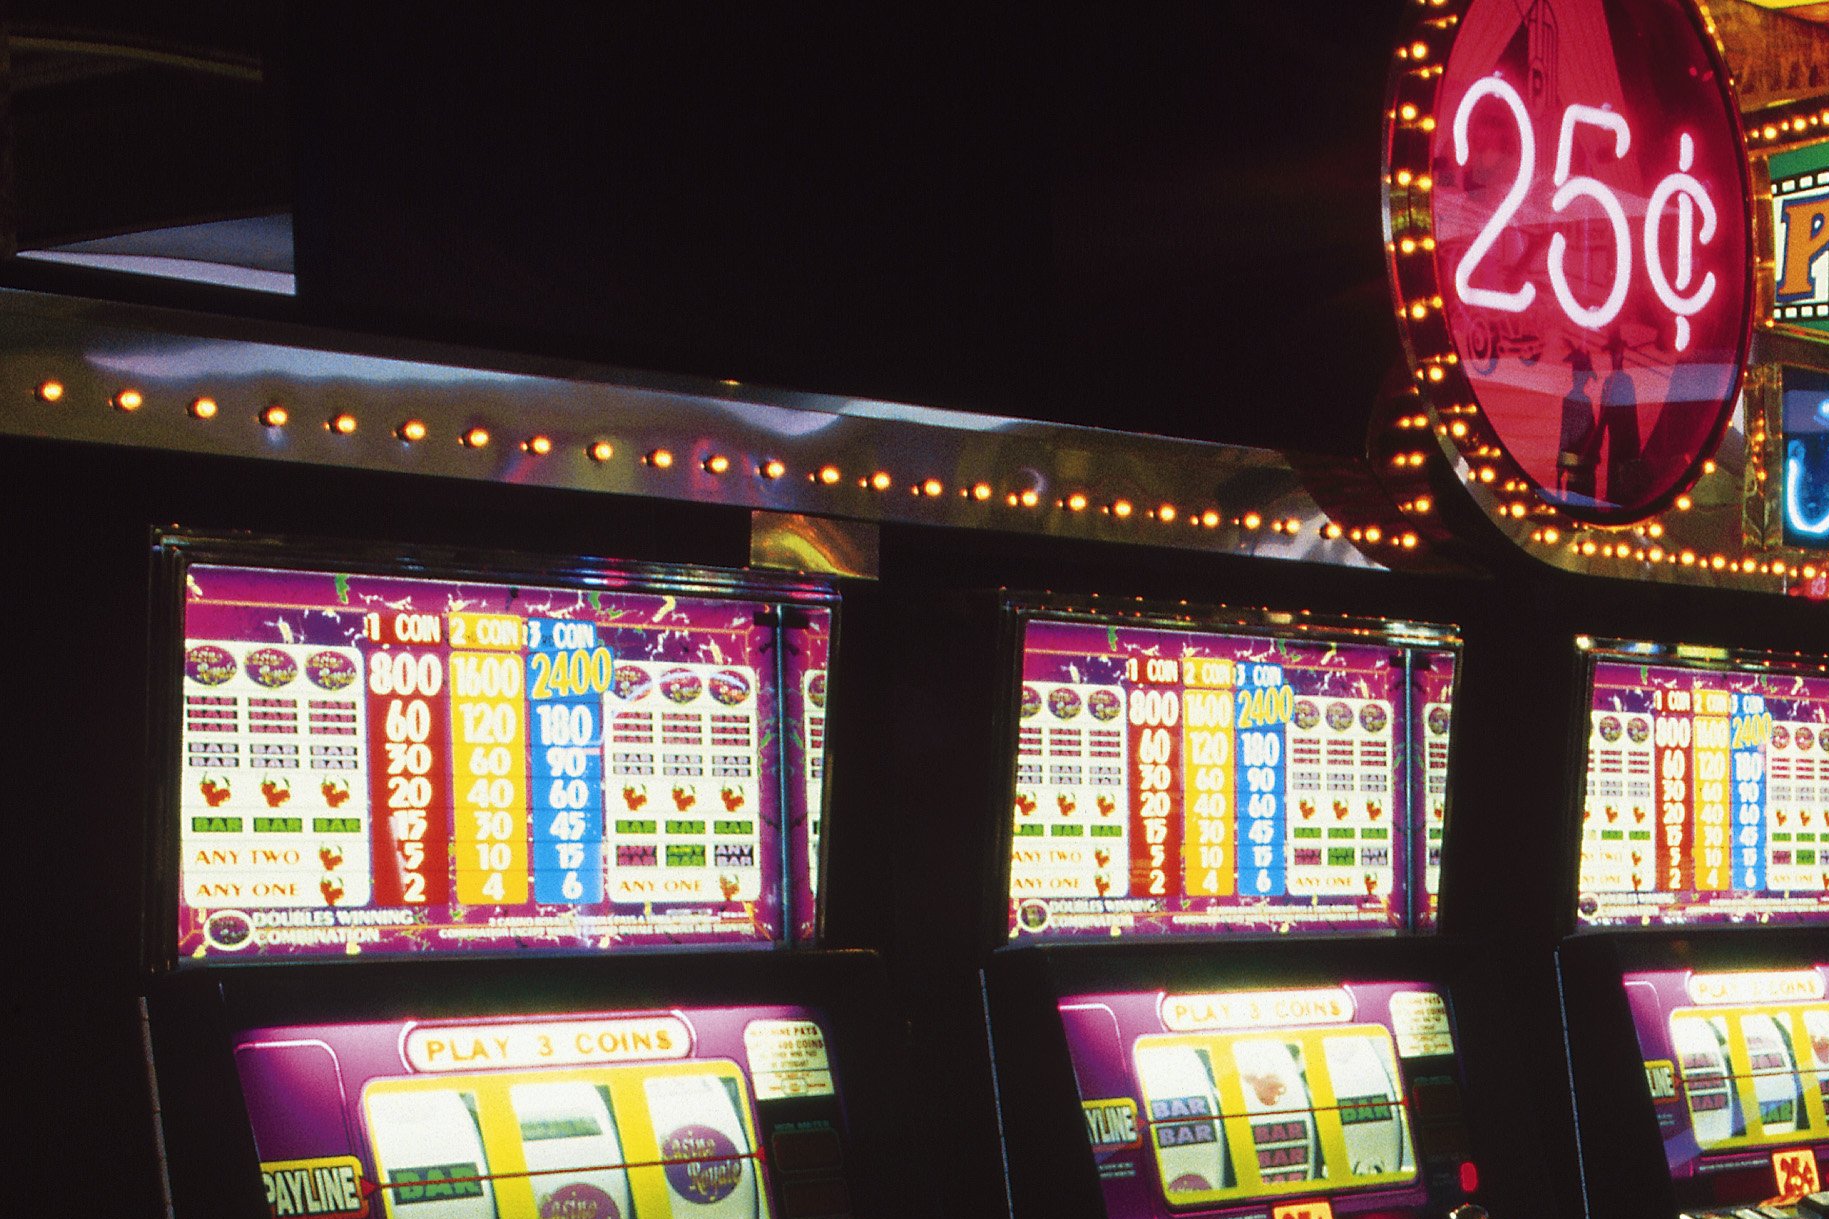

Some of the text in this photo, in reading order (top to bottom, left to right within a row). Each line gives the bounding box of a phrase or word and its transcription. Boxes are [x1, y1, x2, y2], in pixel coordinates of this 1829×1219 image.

[1453, 75, 1717, 352] 25¢
[395, 613, 442, 644] COIN
[450, 616, 522, 649] 2 COIN
[528, 620, 595, 650] 3 COIN
[370, 651, 443, 697] 800
[452, 657, 521, 698] 1600
[531, 646, 614, 700] 2400
[386, 699, 431, 743] 60
[1129, 689, 1180, 727] 800
[1238, 684, 1294, 729] 2400
[459, 702, 517, 744] 120
[536, 703, 593, 746] 180
[385, 742, 433, 775] 30
[1140, 728, 1171, 764] 60
[469, 746, 513, 776] 60
[546, 747, 587, 778] 90
[387, 776, 433, 808] 20
[1139, 764, 1172, 791] 30
[1195, 767, 1225, 791] 60
[466, 778, 515, 808] 40
[549, 778, 589, 809] 60
[1140, 791, 1171, 818] 20
[1193, 792, 1227, 818] 40
[192, 817, 361, 832] BAR BAR BAR
[392, 809, 427, 841] 15
[474, 810, 513, 841] 30
[549, 811, 586, 841] 45
[195, 850, 300, 865] ANY TWO
[403, 842, 425, 870] 5
[475, 842, 512, 871] 10
[555, 842, 585, 870] 15
[715, 845, 752, 855] ANY
[715, 855, 753, 866] BAR
[1013, 850, 1042, 863] ANY
[1151, 844, 1166, 868] 5
[1199, 845, 1225, 869] 10
[197, 883, 299, 897] ANY ONE
[403, 872, 426, 903] 2
[482, 872, 505, 901] 4
[562, 871, 584, 900] 6
[620, 879, 703, 892] ANY ONE
[1014, 878, 1042, 889] ANY
[1149, 869, 1166, 895] 2
[1201, 869, 1219, 894] 4
[1669, 867, 1681, 889] 2
[1707, 868, 1719, 889] 4
[253, 909, 413, 927] DOUBLES WINNING
[253, 929, 381, 945] COMBINATION
[1175, 1003, 1231, 1023] PLAY
[1275, 1000, 1342, 1019] COINS
[425, 1030, 673, 1063] PLAY 3 COINS
[1153, 1096, 1210, 1119] BAR
[1342, 1094, 1391, 1121] BAR
[1158, 1124, 1215, 1146] BAR
[1253, 1121, 1305, 1143] BAR
[1258, 1148, 1306, 1168] BAR
[262, 1165, 362, 1216] PAYLINE
[395, 1166, 482, 1200] BAR
